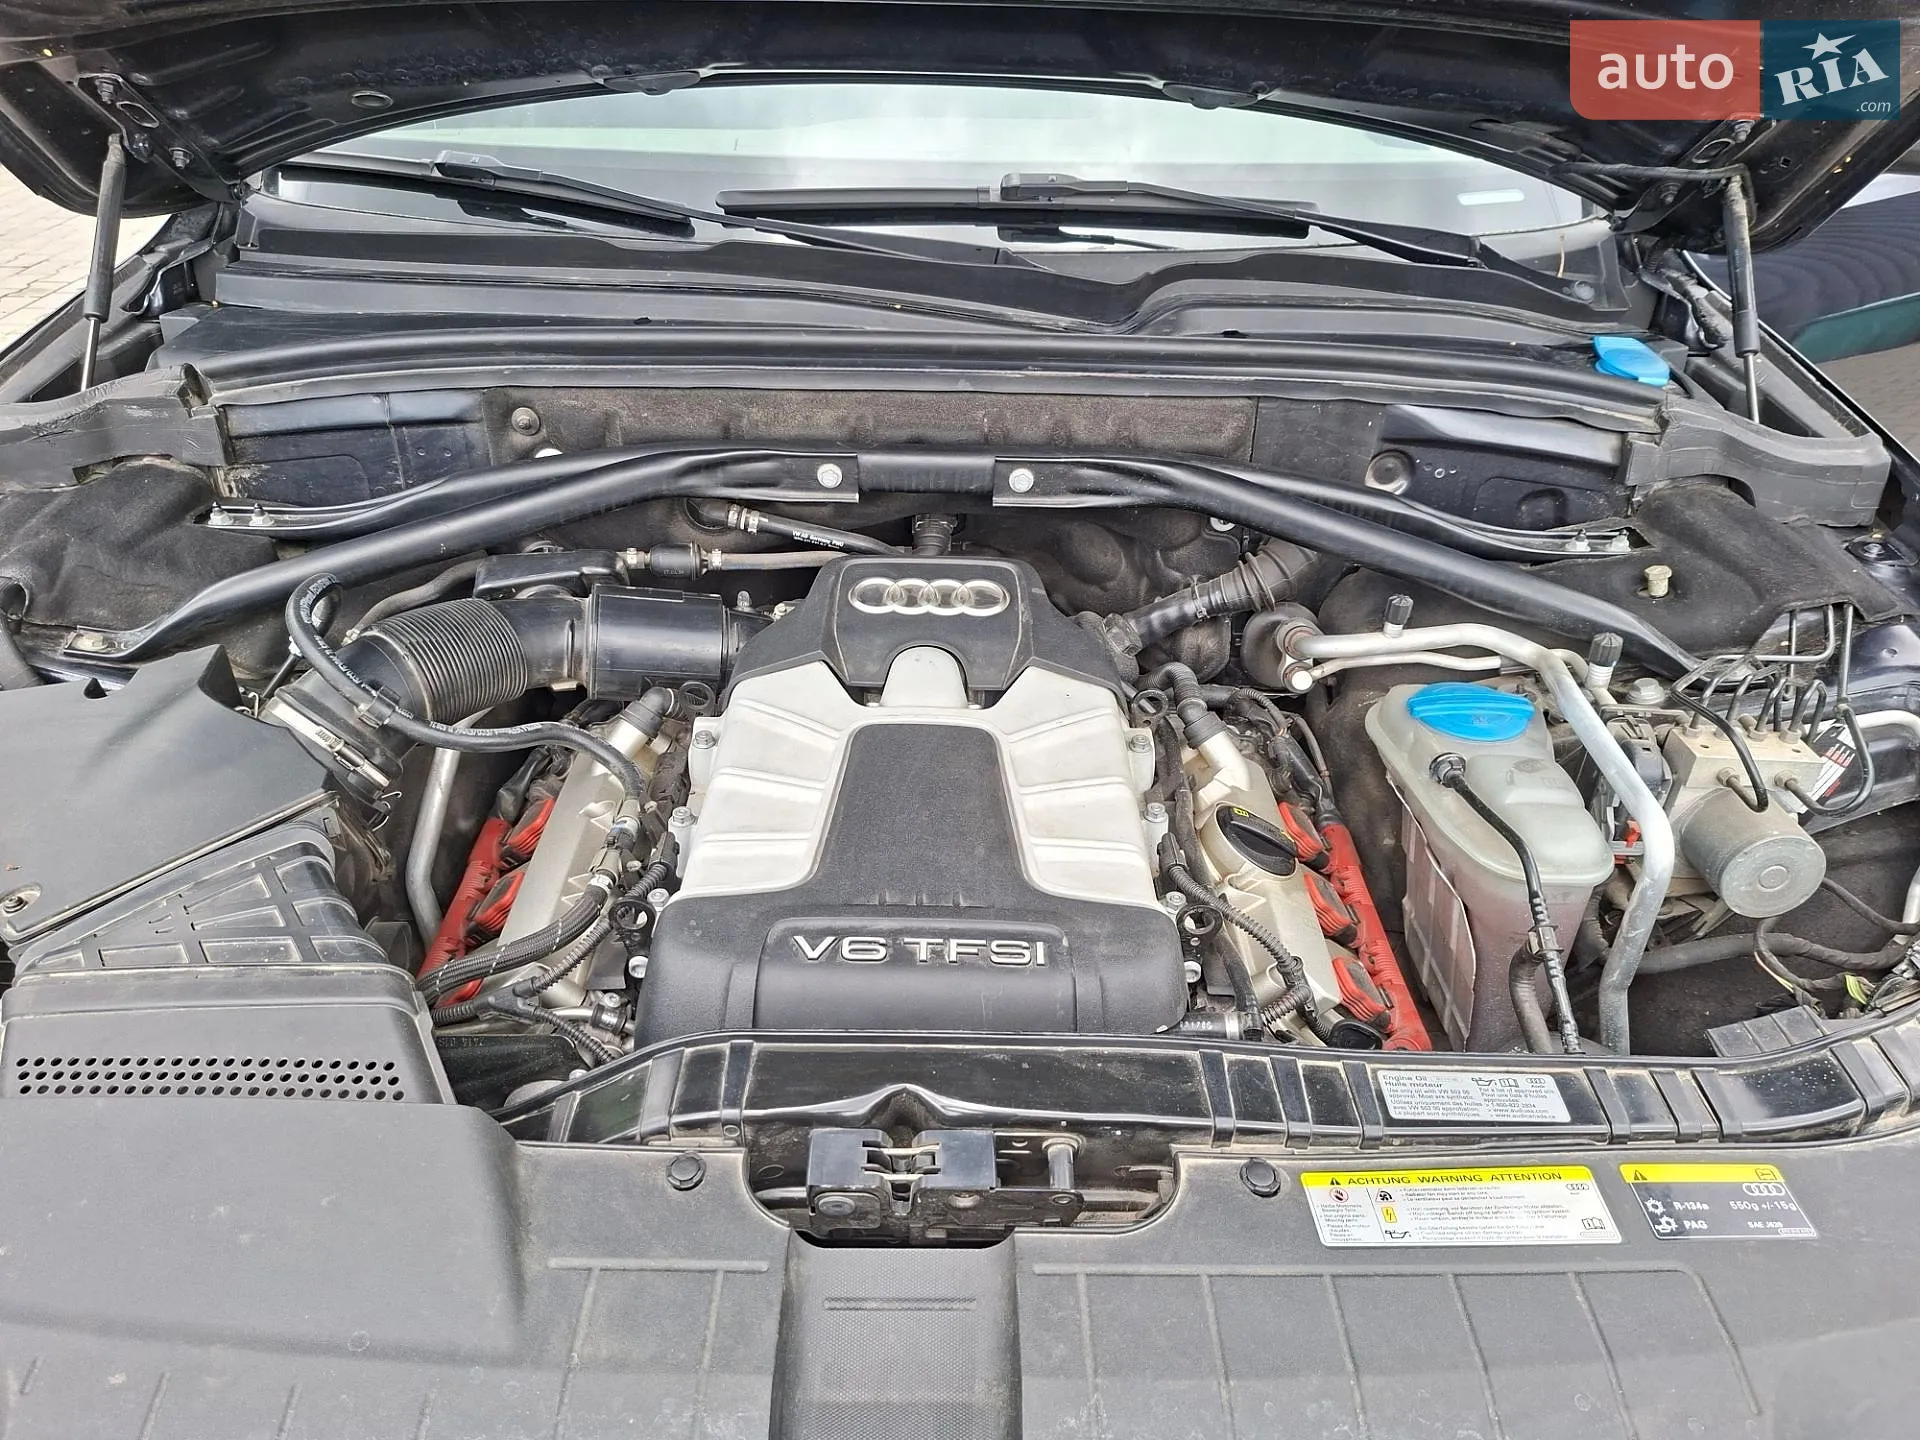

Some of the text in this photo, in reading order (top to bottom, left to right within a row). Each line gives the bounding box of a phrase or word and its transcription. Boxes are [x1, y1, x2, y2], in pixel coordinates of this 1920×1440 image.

[793, 935, 1046, 967] V6 TFSI
[1348, 1172, 1562, 1185] ACHTUNG WARNING ATTENTION
[1672, 1201, 1710, 1210] R-134a
[1728, 1200, 1760, 1212] 550g
[1683, 1220, 1708, 1230] PAG
[1746, 1220, 1764, 1228] SAE
